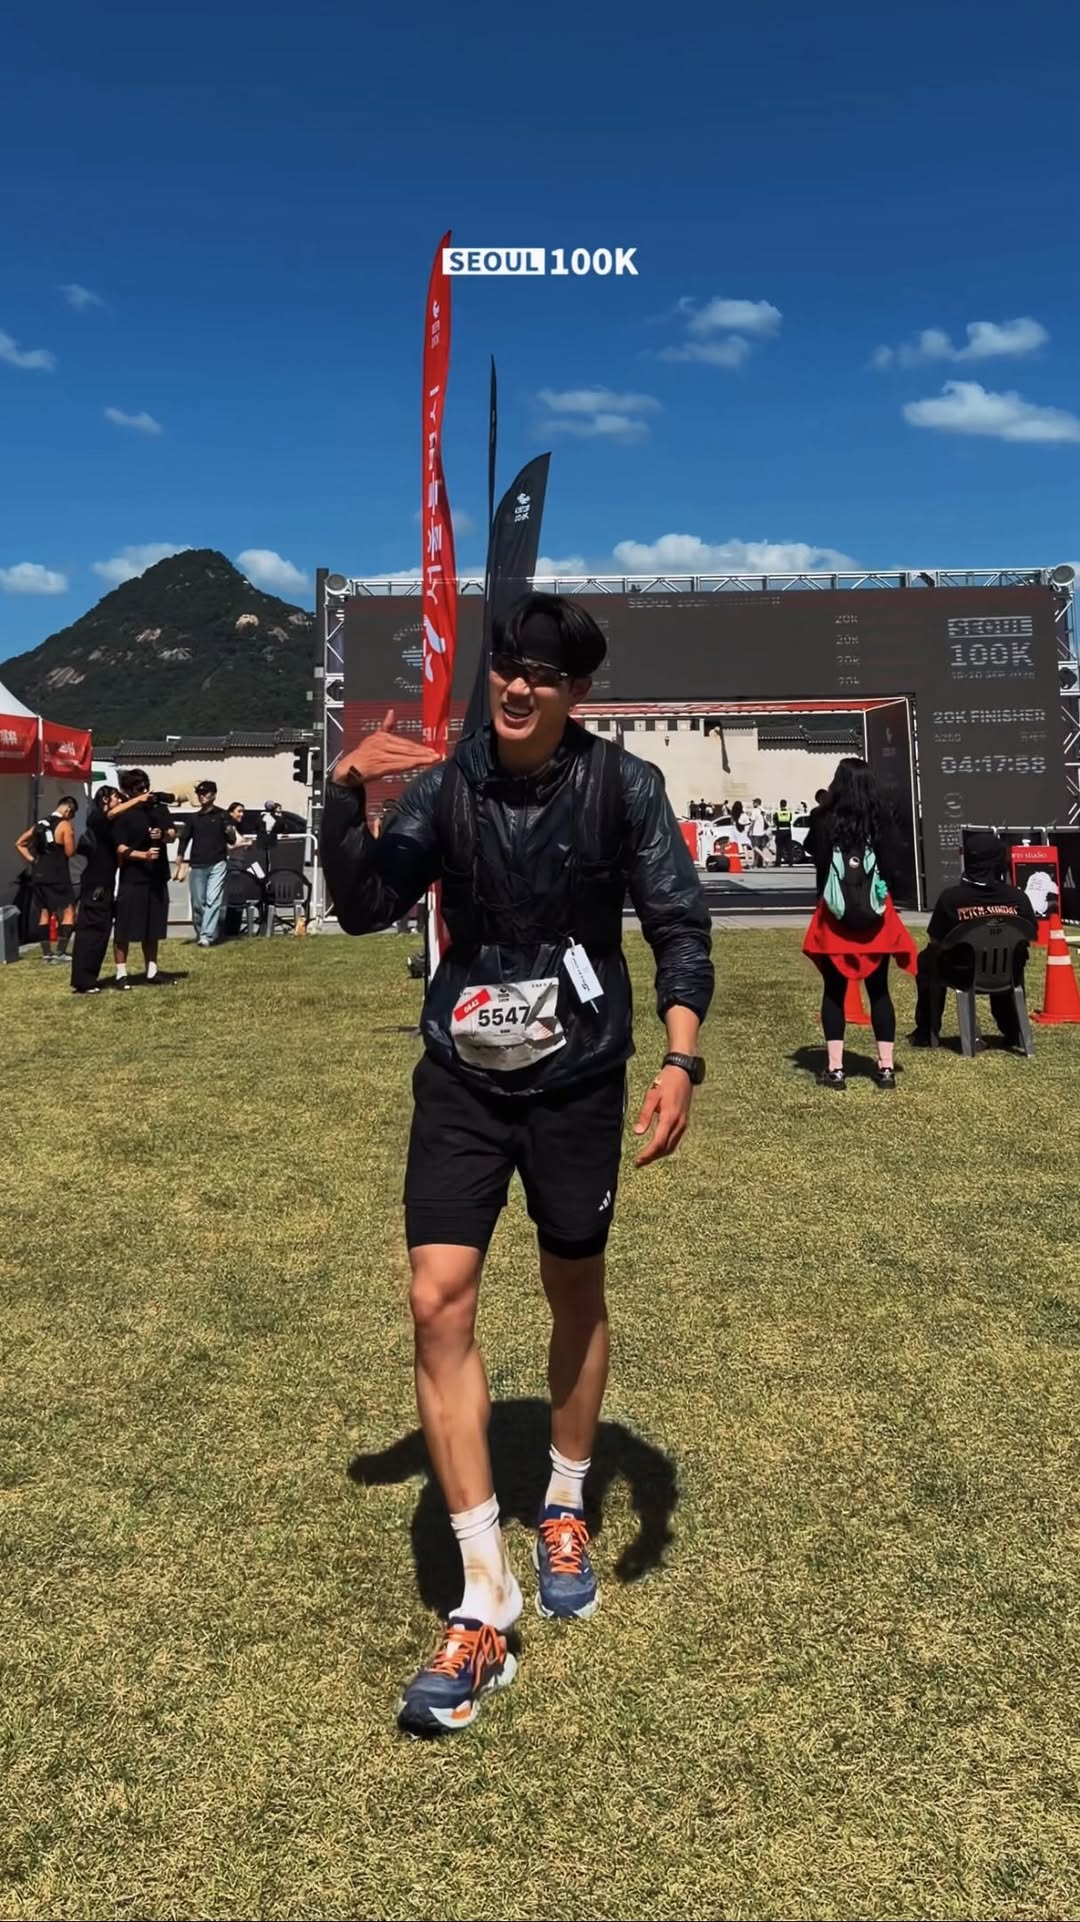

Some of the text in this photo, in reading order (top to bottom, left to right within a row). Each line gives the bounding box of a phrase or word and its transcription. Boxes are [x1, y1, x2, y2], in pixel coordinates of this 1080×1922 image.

[950, 641, 1035, 667] 100K
[933, 708, 1046, 724] 20K FINISHER
[941, 755, 1047, 774] 04:17:58
[478, 1006, 532, 1028] 5547
